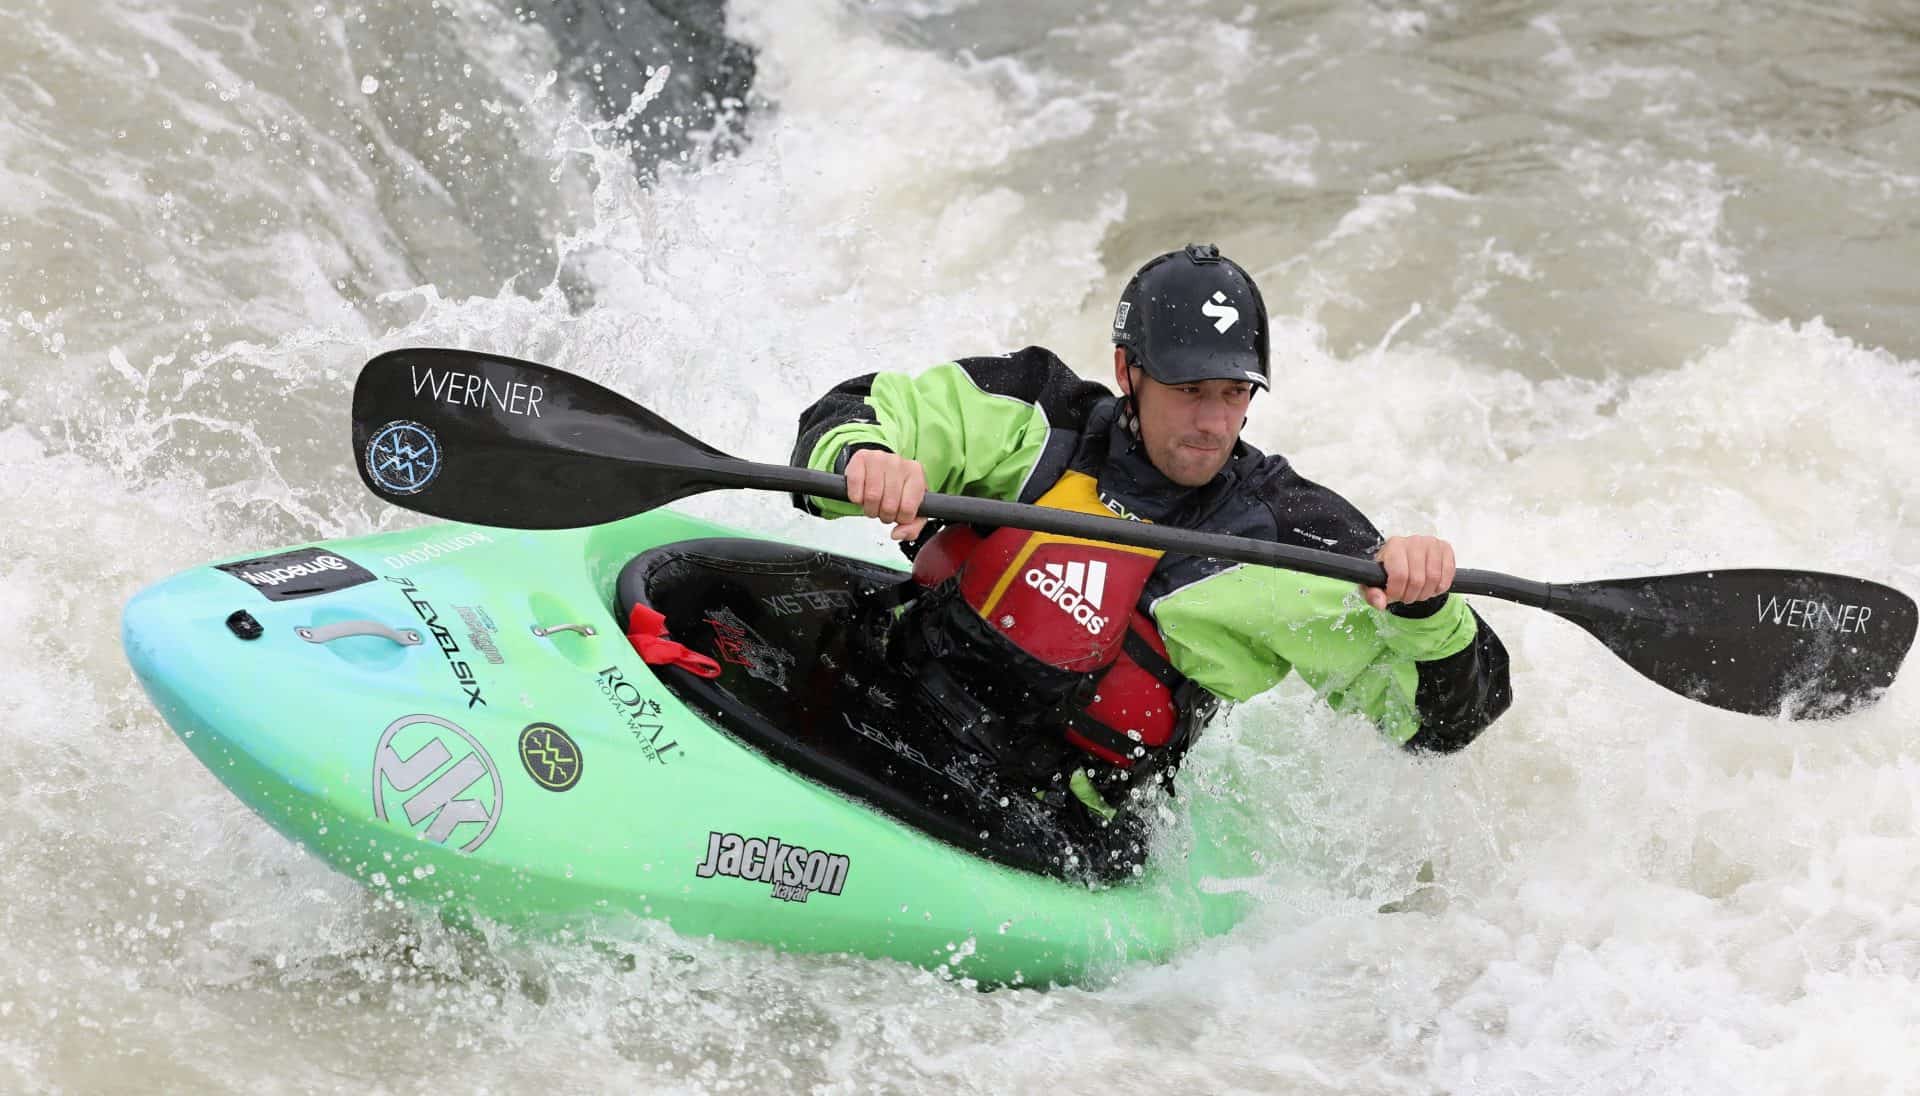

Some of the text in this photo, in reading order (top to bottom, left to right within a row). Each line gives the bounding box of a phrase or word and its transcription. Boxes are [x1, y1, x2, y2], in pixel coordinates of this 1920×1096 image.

[411, 365, 544, 418] WERNER
[1099, 492, 1142, 521] LEV
[1025, 568, 1105, 635] adidas
[1756, 594, 1873, 635] WERNER
[598, 666, 679, 766] ROYAL
[626, 718, 657, 762] WATER
